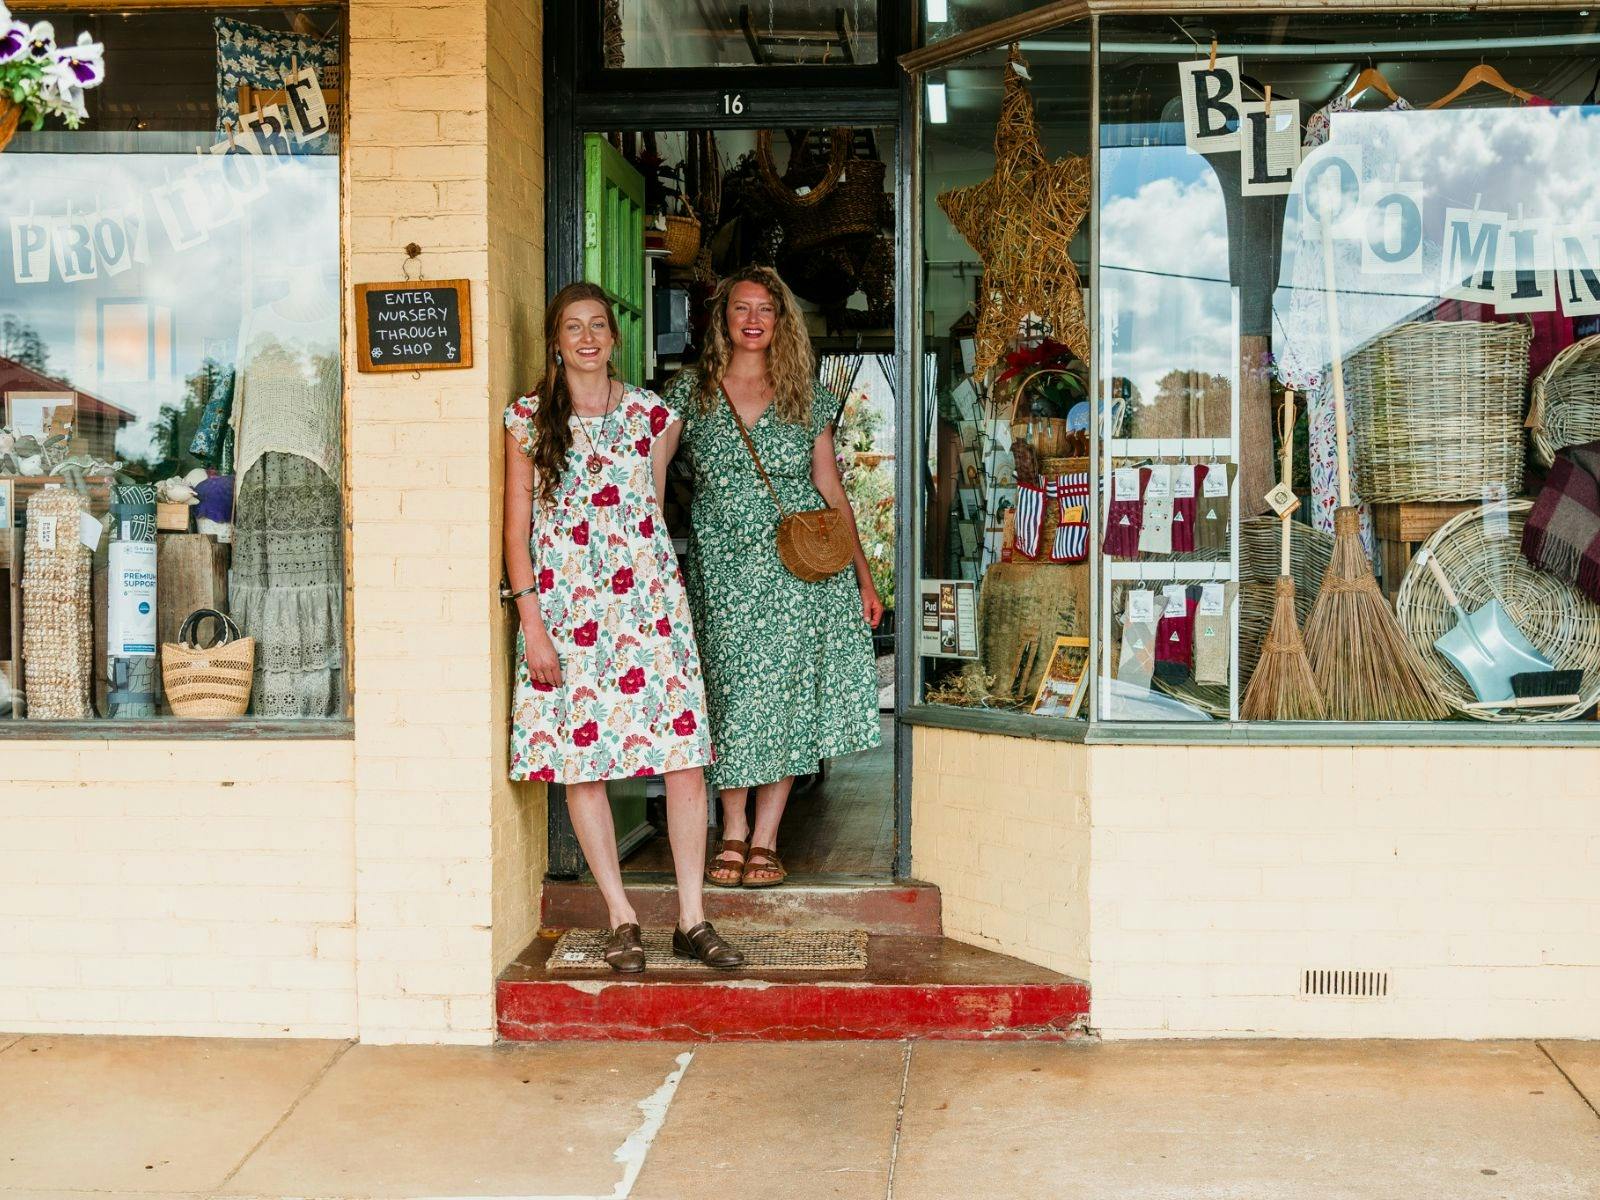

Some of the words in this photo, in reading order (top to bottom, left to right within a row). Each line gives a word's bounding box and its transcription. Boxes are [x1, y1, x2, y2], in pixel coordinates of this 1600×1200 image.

[723, 94, 744, 115] 16
[385, 291, 435, 305] ENTER
[378, 307, 448, 322] NURSERY
[376, 326, 448, 340] THROUGH
[392, 342, 433, 356] SHOP
[924, 601, 937, 611] Pud
